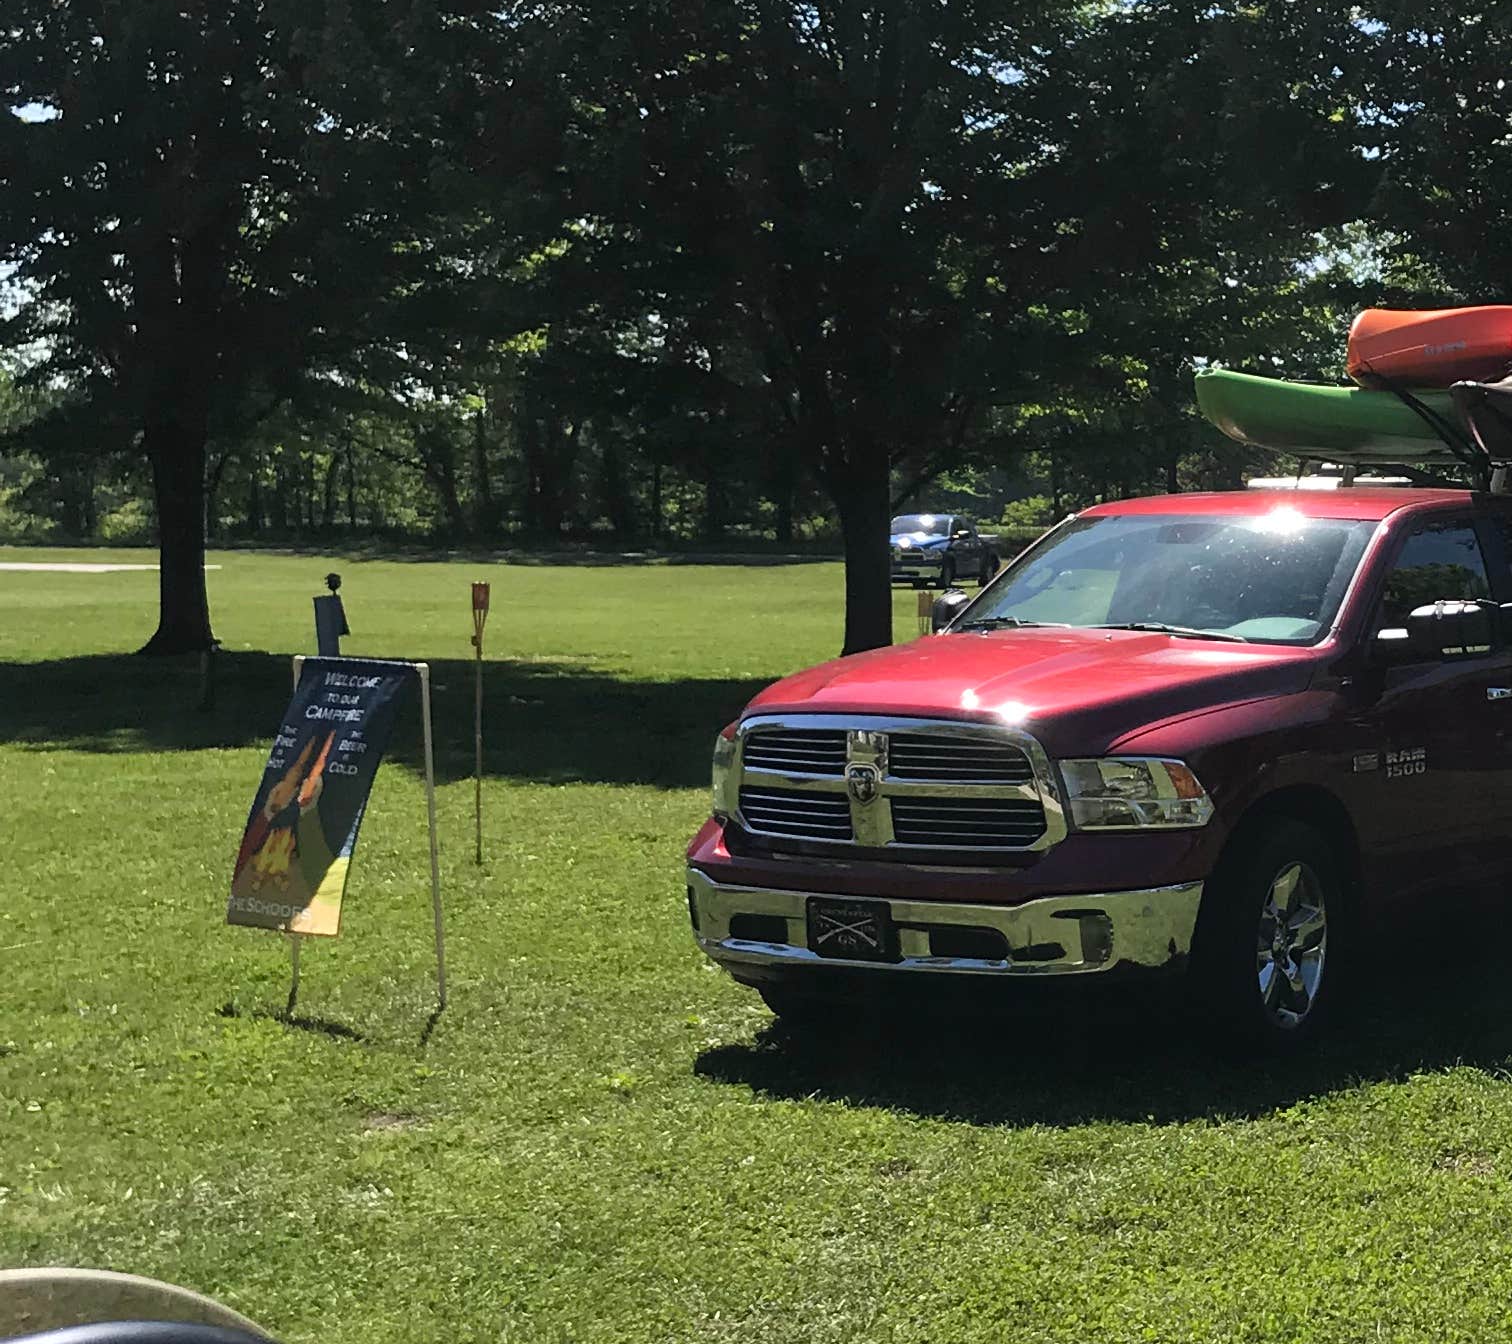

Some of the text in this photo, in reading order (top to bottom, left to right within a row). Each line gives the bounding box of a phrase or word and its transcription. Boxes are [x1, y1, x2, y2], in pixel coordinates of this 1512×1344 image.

[324, 672, 382, 688] WELCOME
[327, 692, 360, 705] TO OUR
[305, 705, 365, 722] CAMPFIRE
[338, 739, 367, 753] BEER
[328, 761, 359, 775] COLD
[1386, 761, 1426, 778] 1500
